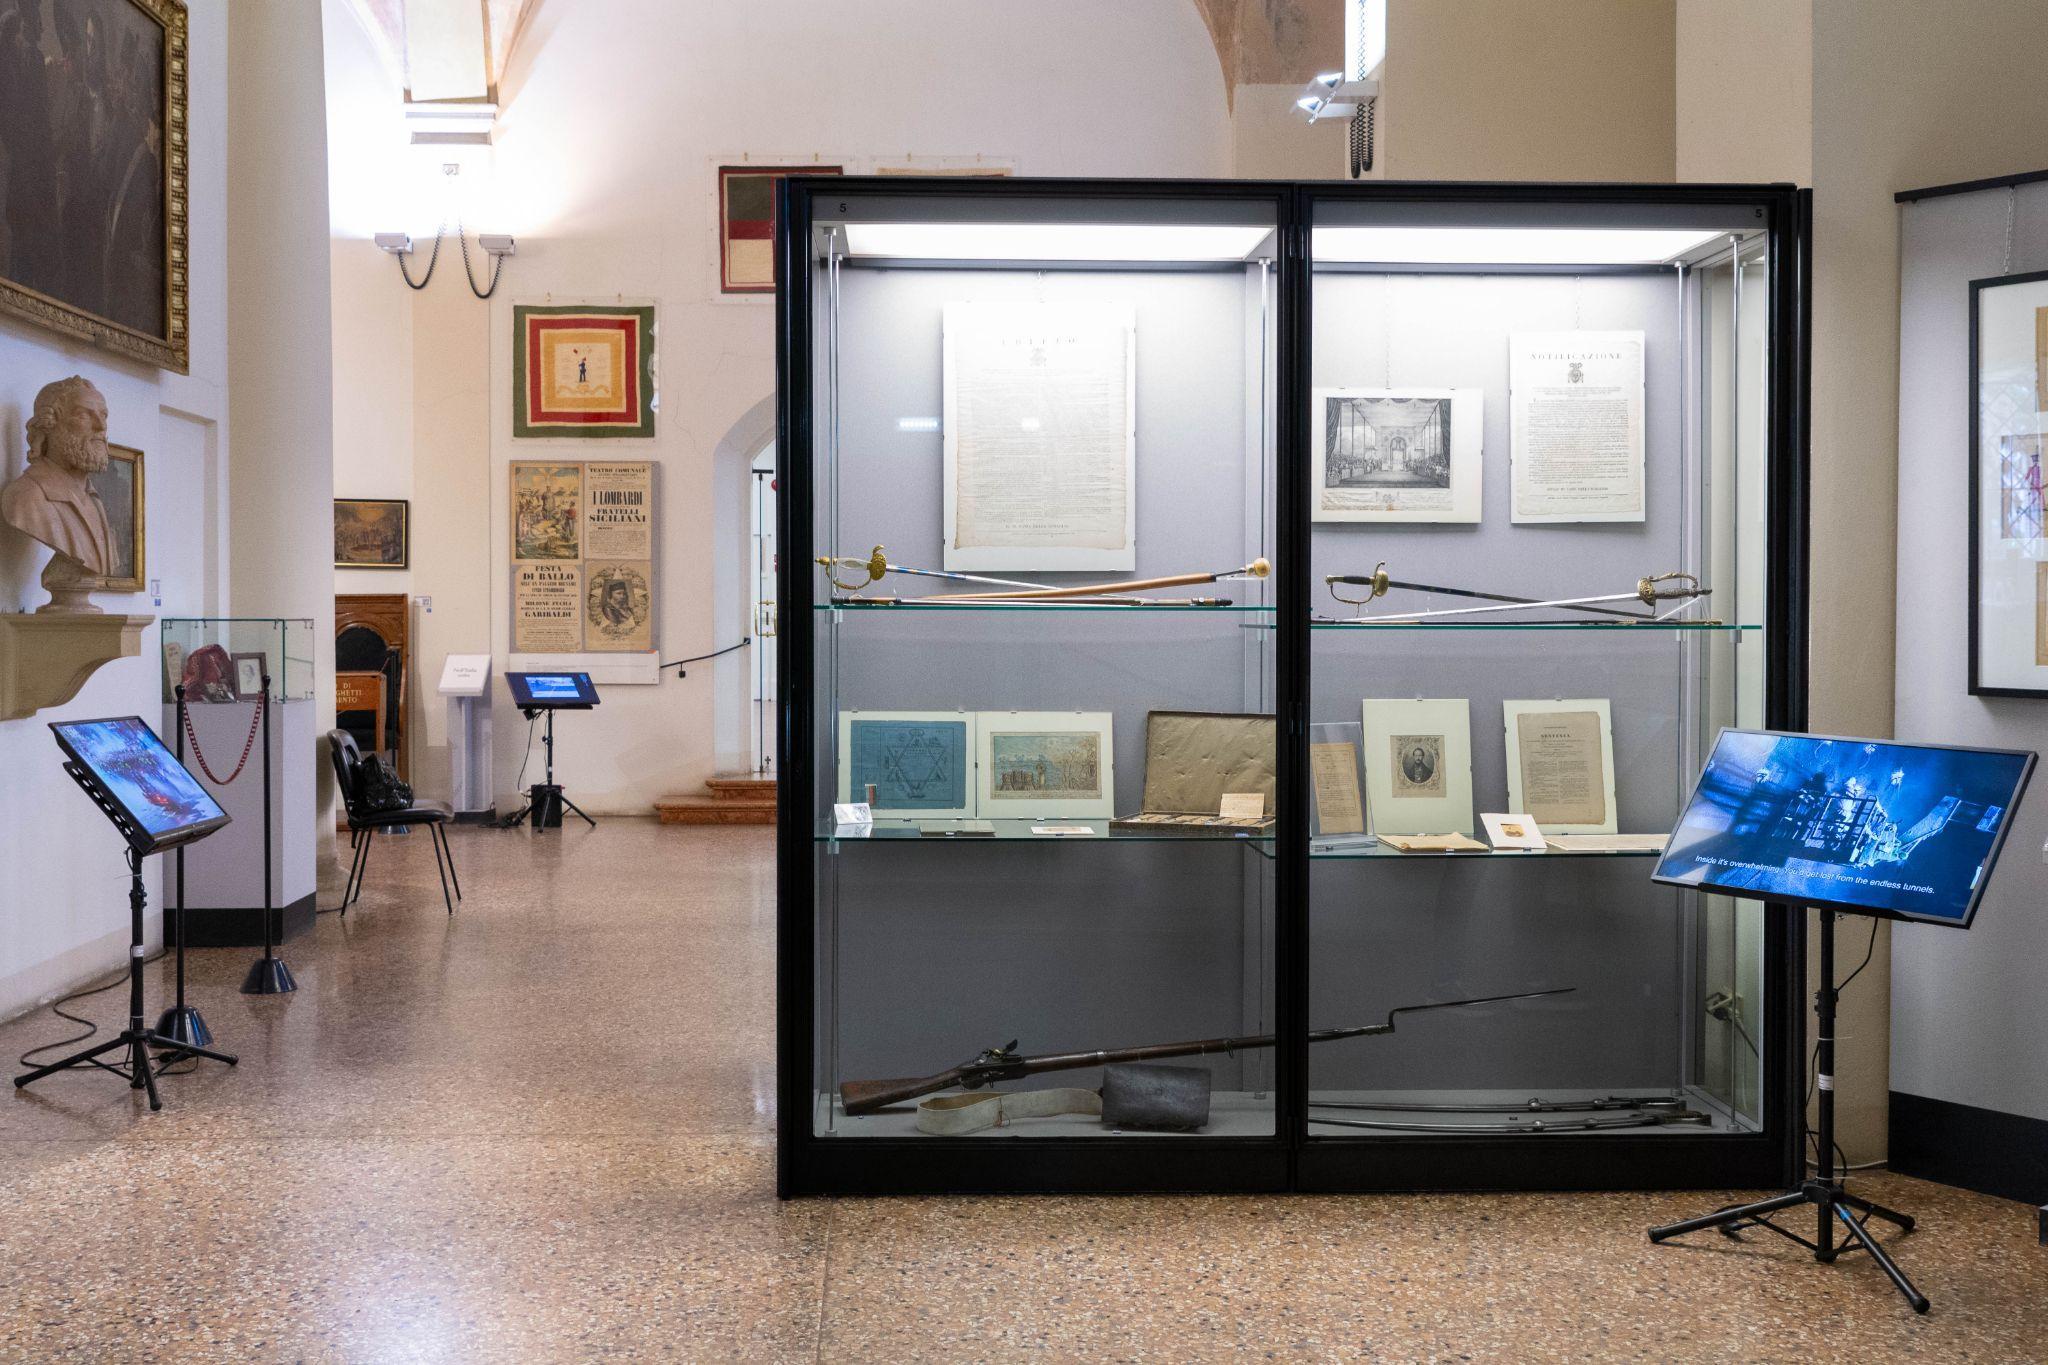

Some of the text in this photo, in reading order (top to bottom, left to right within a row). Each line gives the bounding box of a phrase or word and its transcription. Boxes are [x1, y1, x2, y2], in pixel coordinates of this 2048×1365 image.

[839, 203, 847, 213] 5
[593, 490, 643, 506] I LOMBARDI
[523, 572, 574, 581] DI BALLO
[1695, 855, 1717, 865] Inside
[1717, 858, 1729, 866] it's
[1784, 866, 1804, 876] You'd
[1806, 870, 1819, 879] get
[1819, 872, 1835, 880] lost
[1835, 873, 1854, 883] from
[1855, 876, 1869, 885] the
[1869, 879, 1902, 890] endless
[1903, 882, 1936, 894] tunnels.
